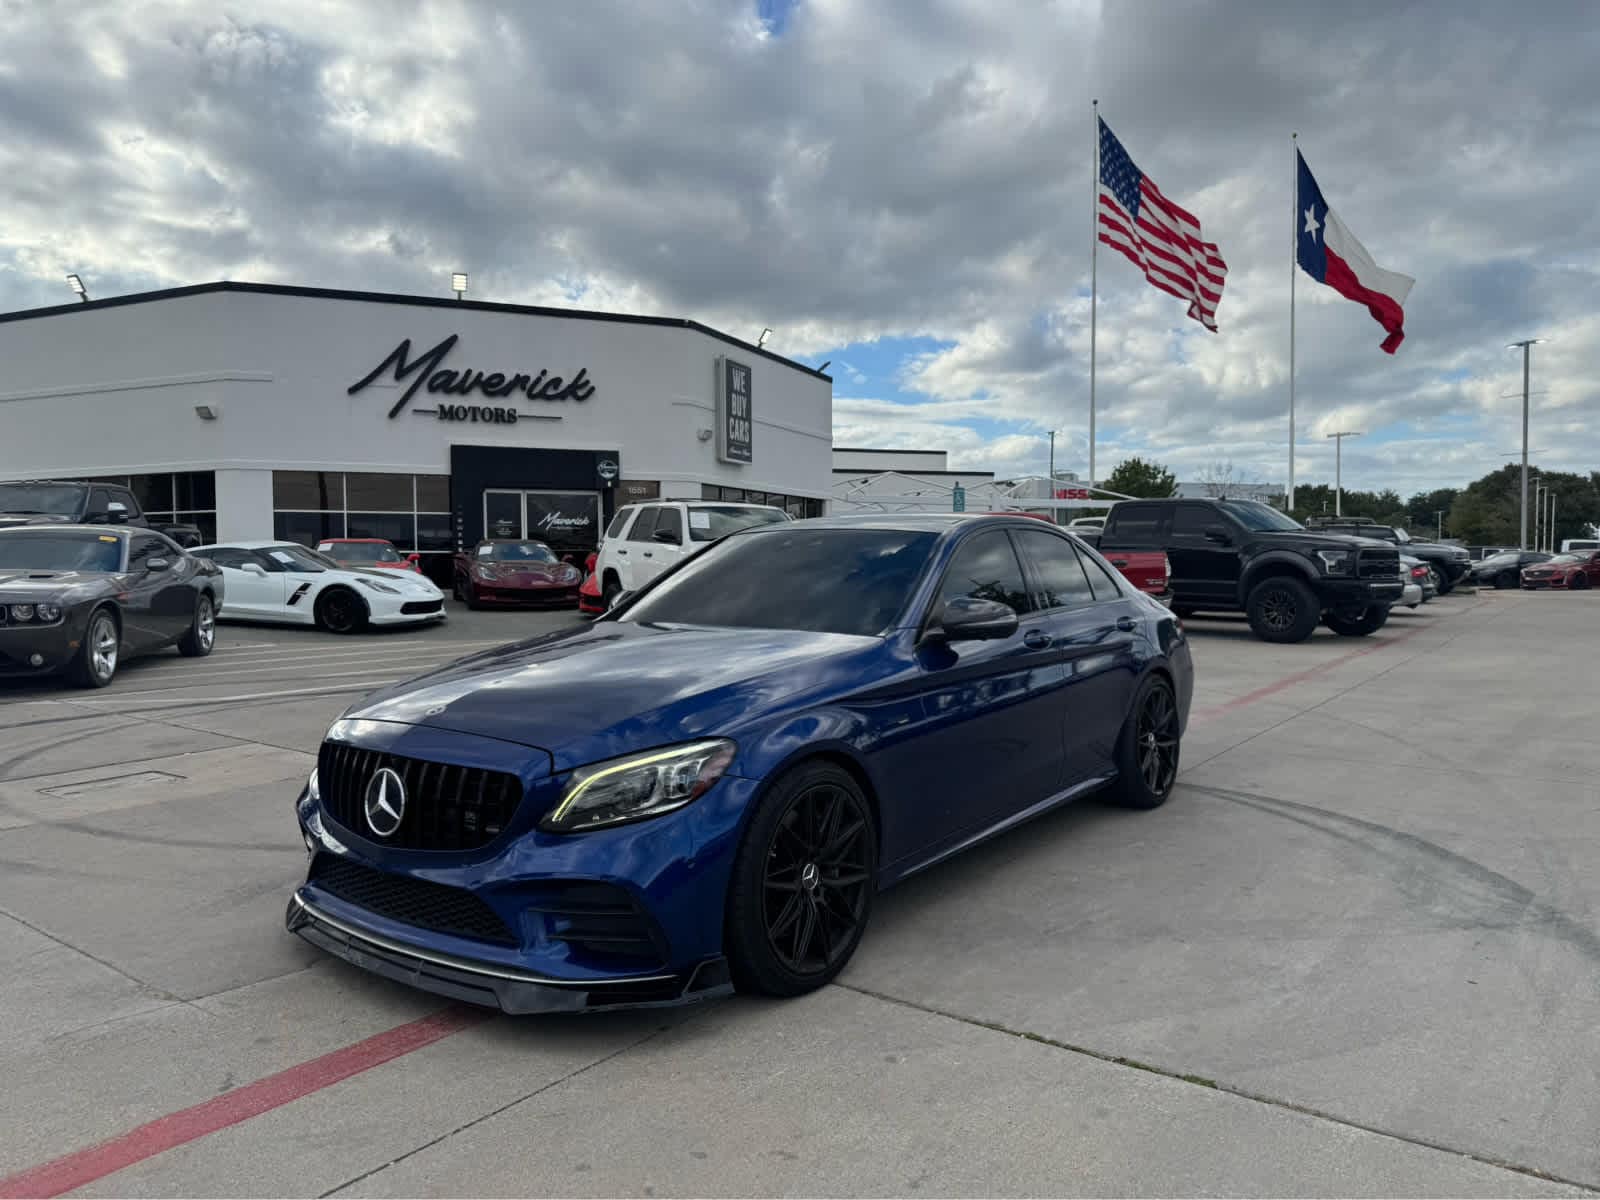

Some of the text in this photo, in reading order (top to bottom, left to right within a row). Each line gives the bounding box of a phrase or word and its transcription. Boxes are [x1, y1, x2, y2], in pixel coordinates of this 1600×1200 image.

[348, 333, 595, 419] Maverick
[732, 368, 746, 392] WE
[438, 404, 518, 424] MOTORS
[731, 393, 747, 417] BUY
[729, 417, 750, 442] CARS
[537, 511, 590, 530] Maverick
